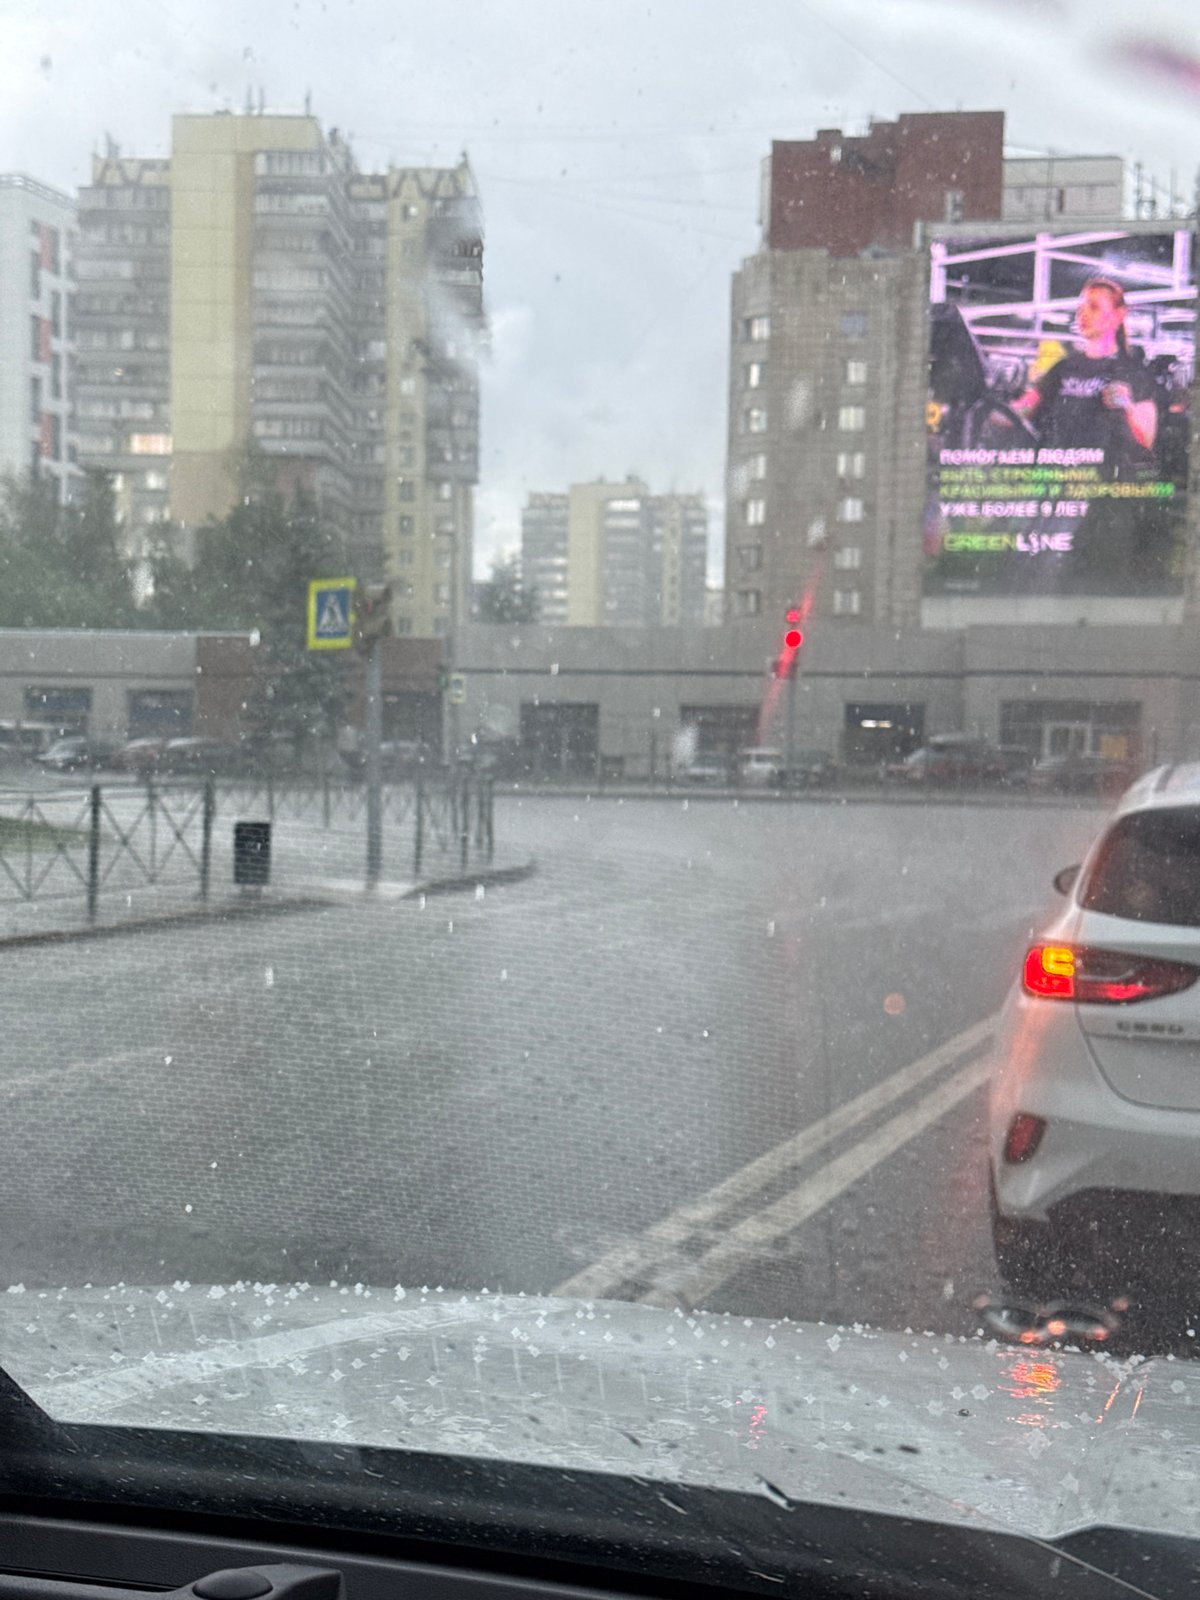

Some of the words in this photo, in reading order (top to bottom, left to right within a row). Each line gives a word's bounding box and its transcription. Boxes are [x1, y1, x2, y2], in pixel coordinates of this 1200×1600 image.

[940, 448, 1034, 465] ПОМОГАЕМ
[1037, 448, 1104, 466] ЛЮДЯМ
[940, 502, 979, 517] УЖЕ
[981, 501, 1038, 517] БОЛЕЕ
[1055, 501, 1089, 517] ЛЕТ
